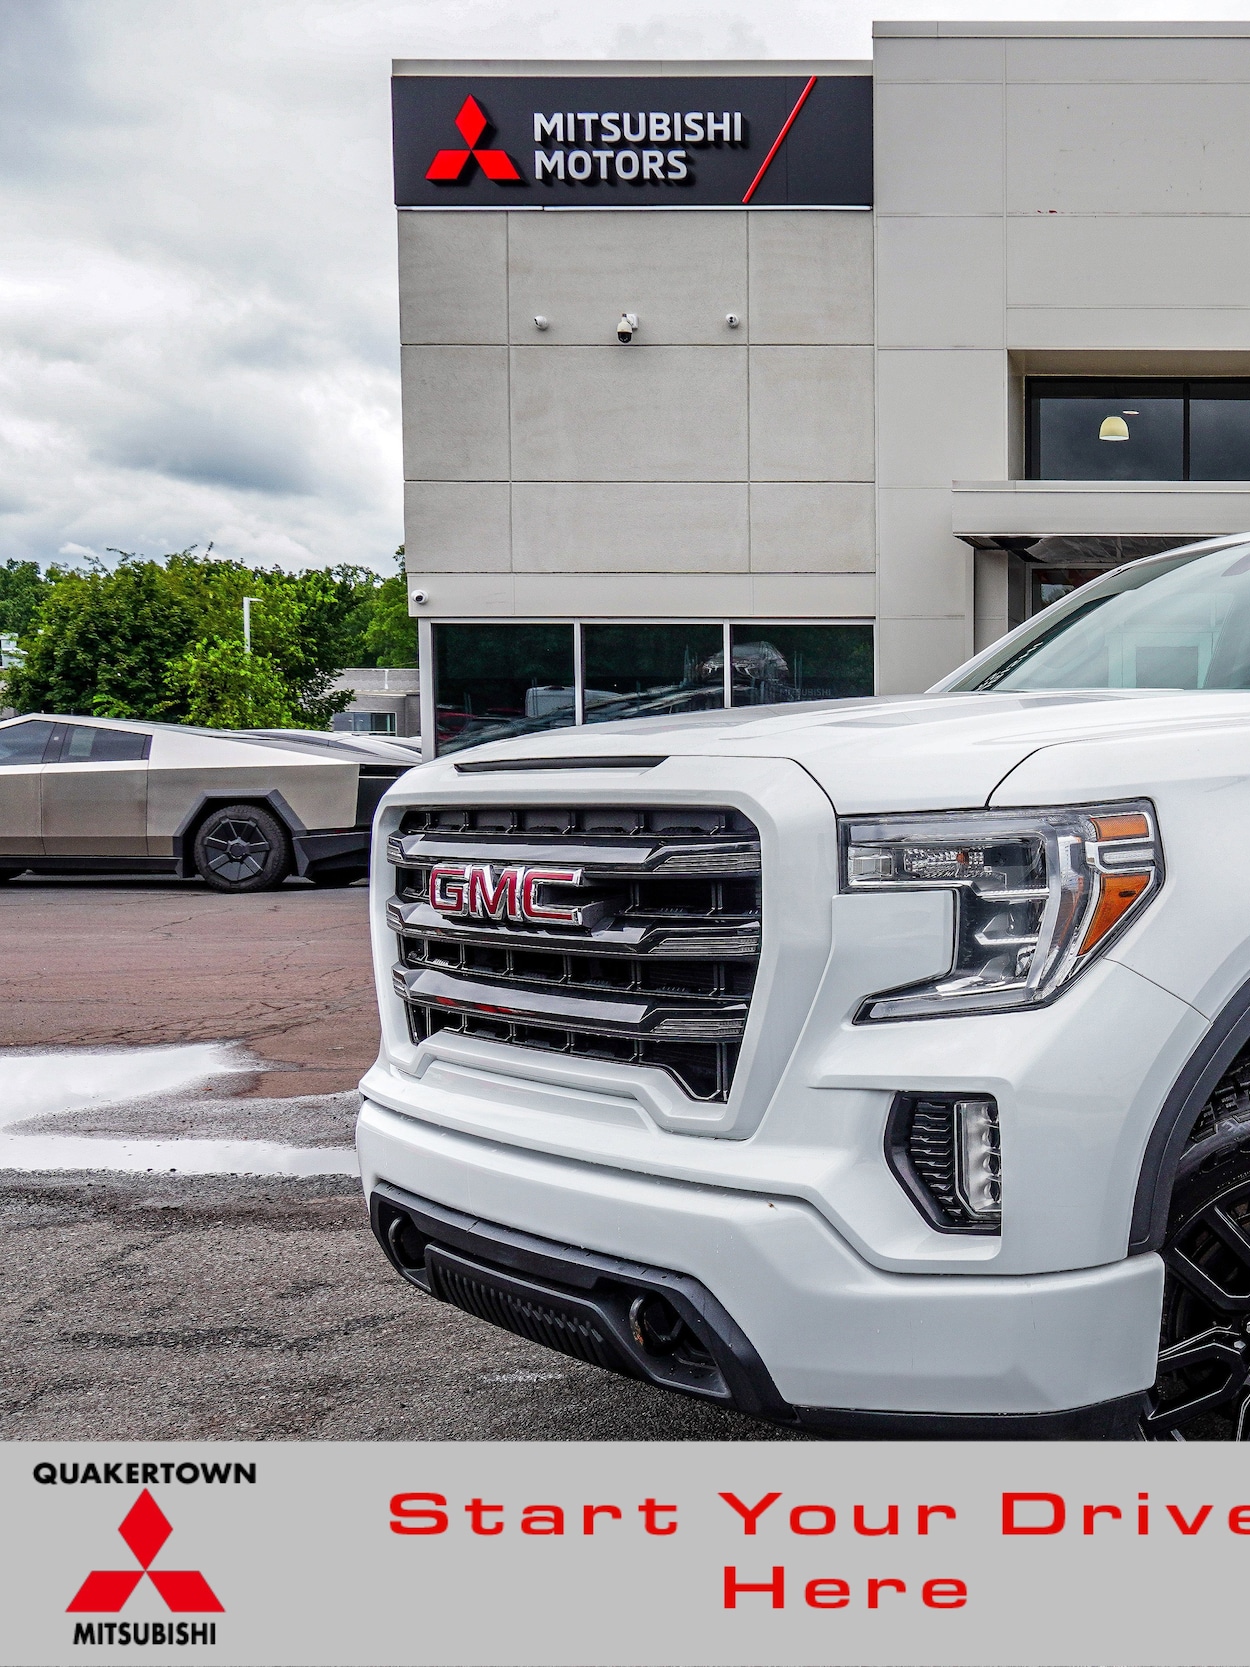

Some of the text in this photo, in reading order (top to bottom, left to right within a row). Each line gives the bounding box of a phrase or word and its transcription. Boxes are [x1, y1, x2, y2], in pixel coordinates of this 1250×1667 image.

[533, 111, 742, 142] MITSUBISHI
[534, 149, 688, 181] MOTORS
[429, 863, 583, 927] GMC
